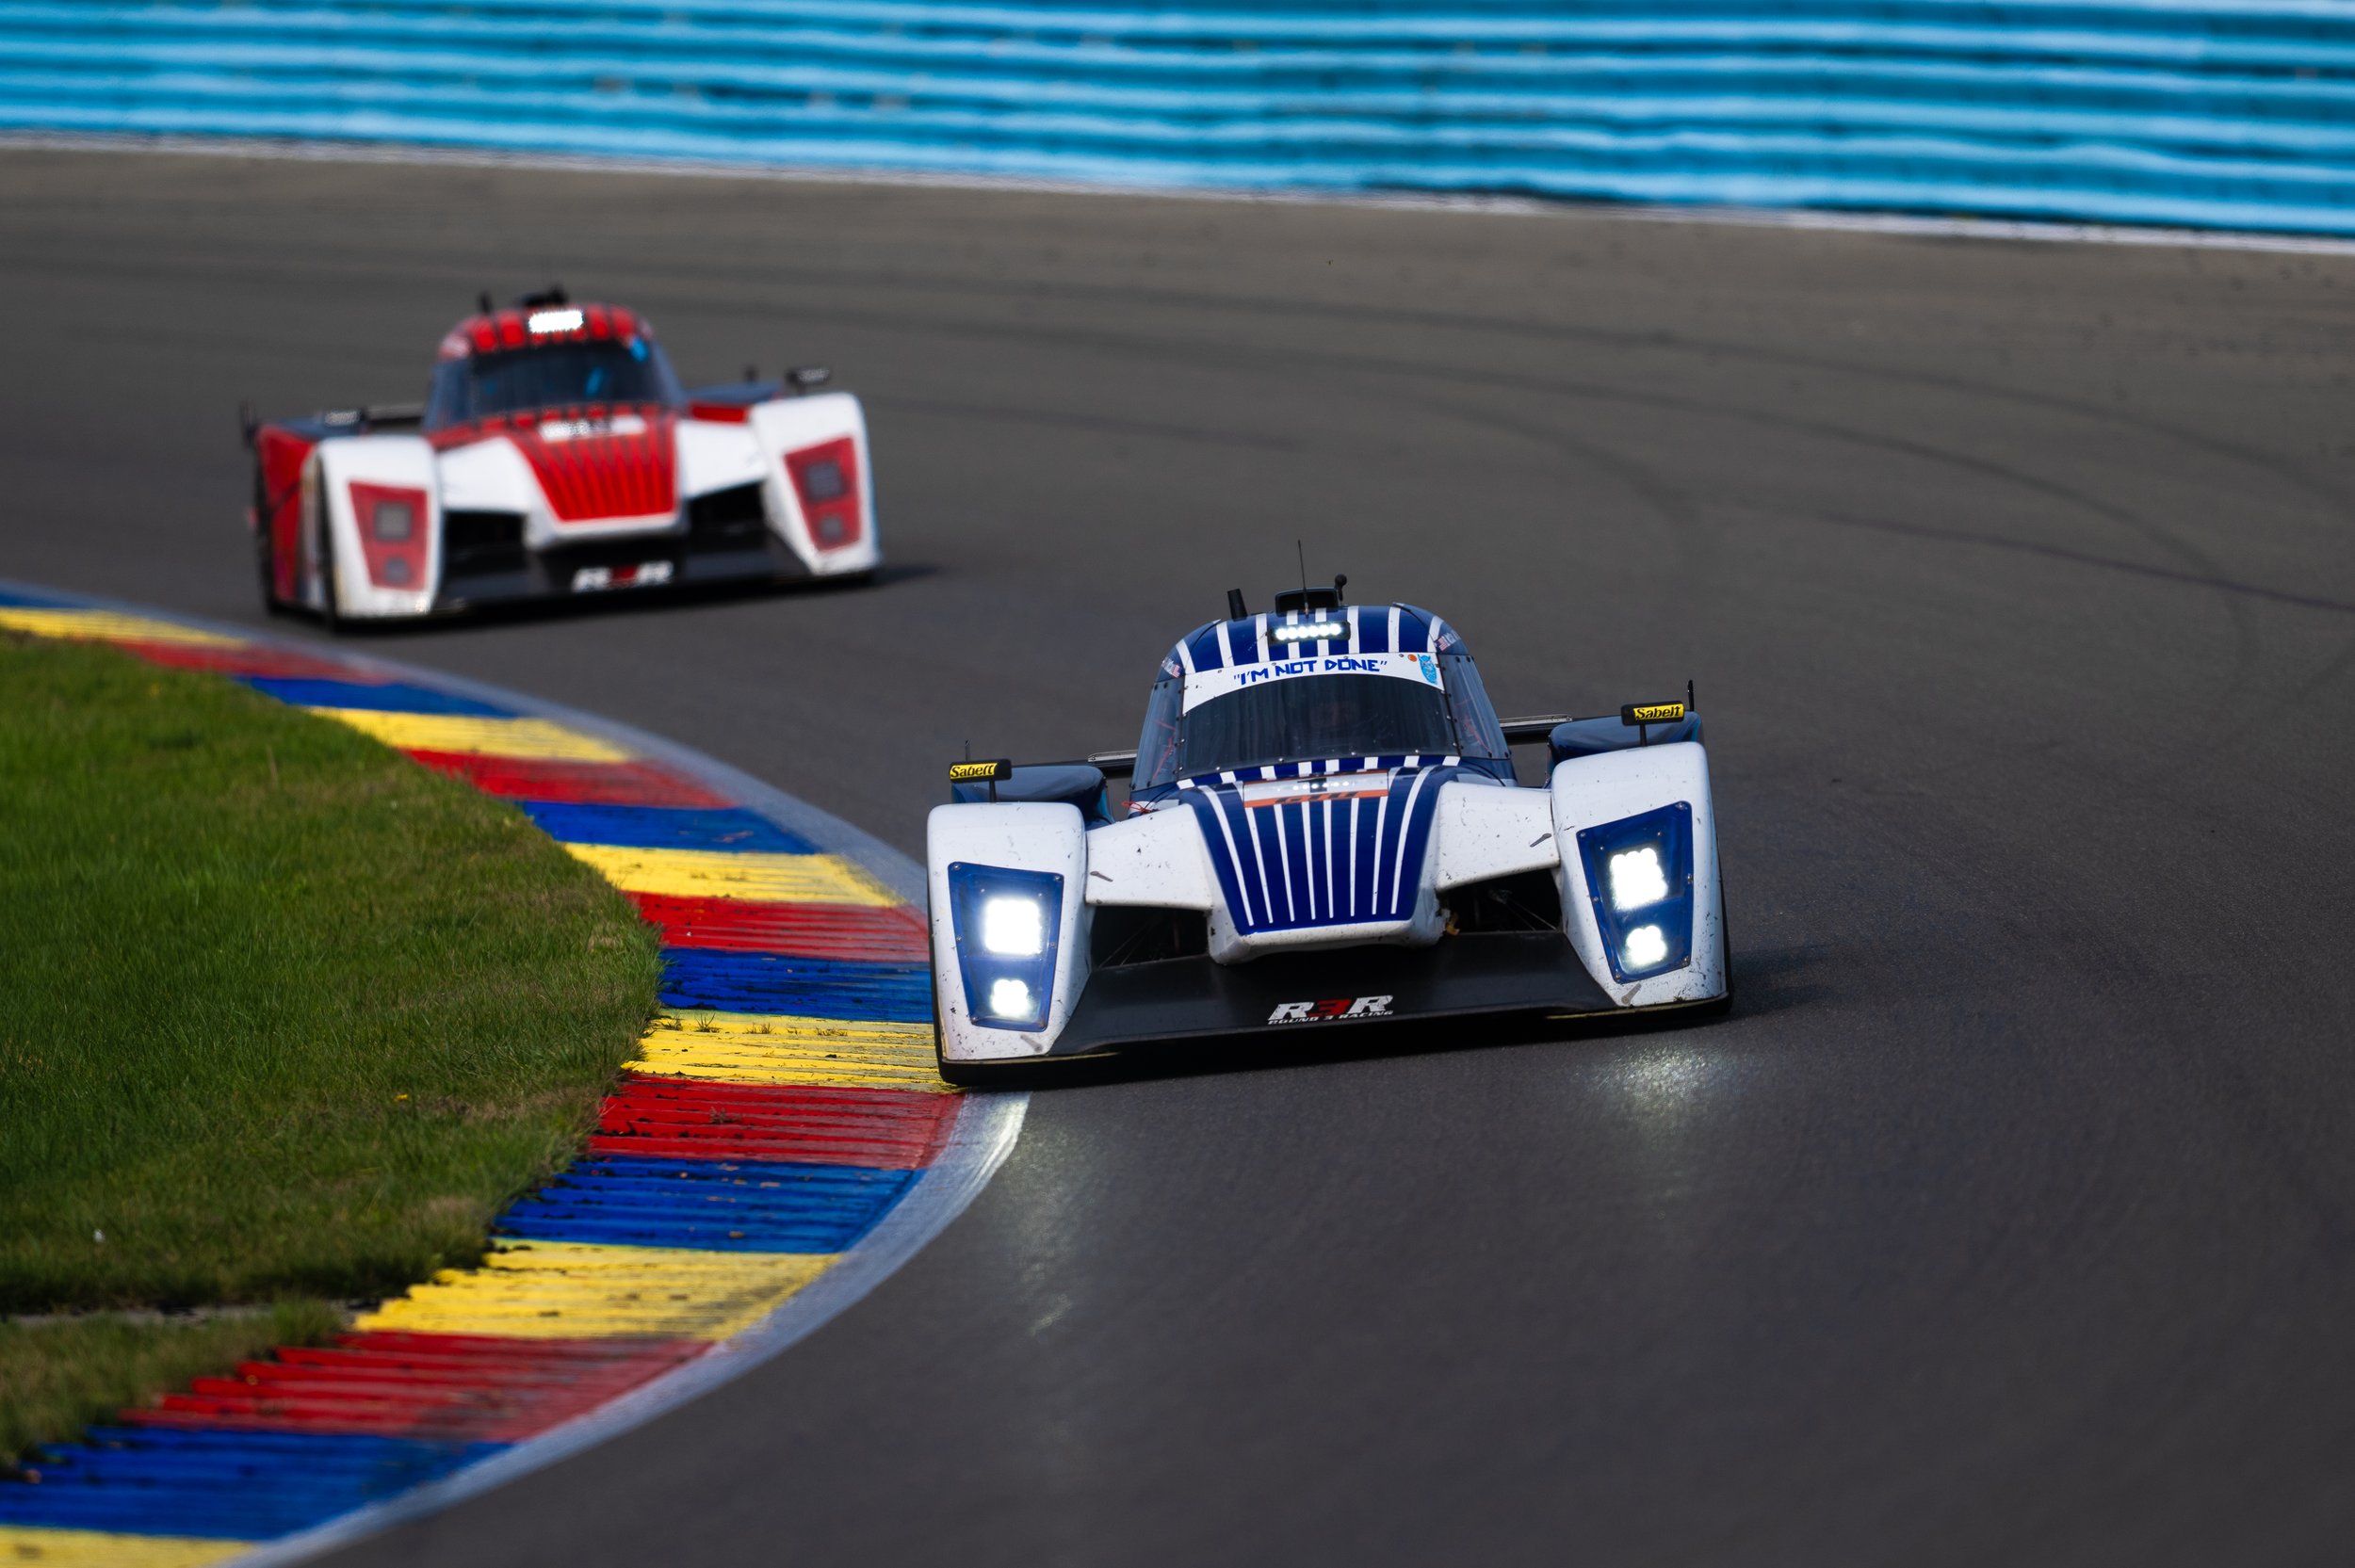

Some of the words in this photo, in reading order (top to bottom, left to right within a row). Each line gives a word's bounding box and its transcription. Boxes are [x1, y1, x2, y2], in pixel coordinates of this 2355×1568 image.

[1275, 660, 1317, 677] NOT
[1634, 705, 1681, 719] Sabelt
[1268, 994, 1394, 1021] R3R
[1339, 1010, 1394, 1019] RACING
